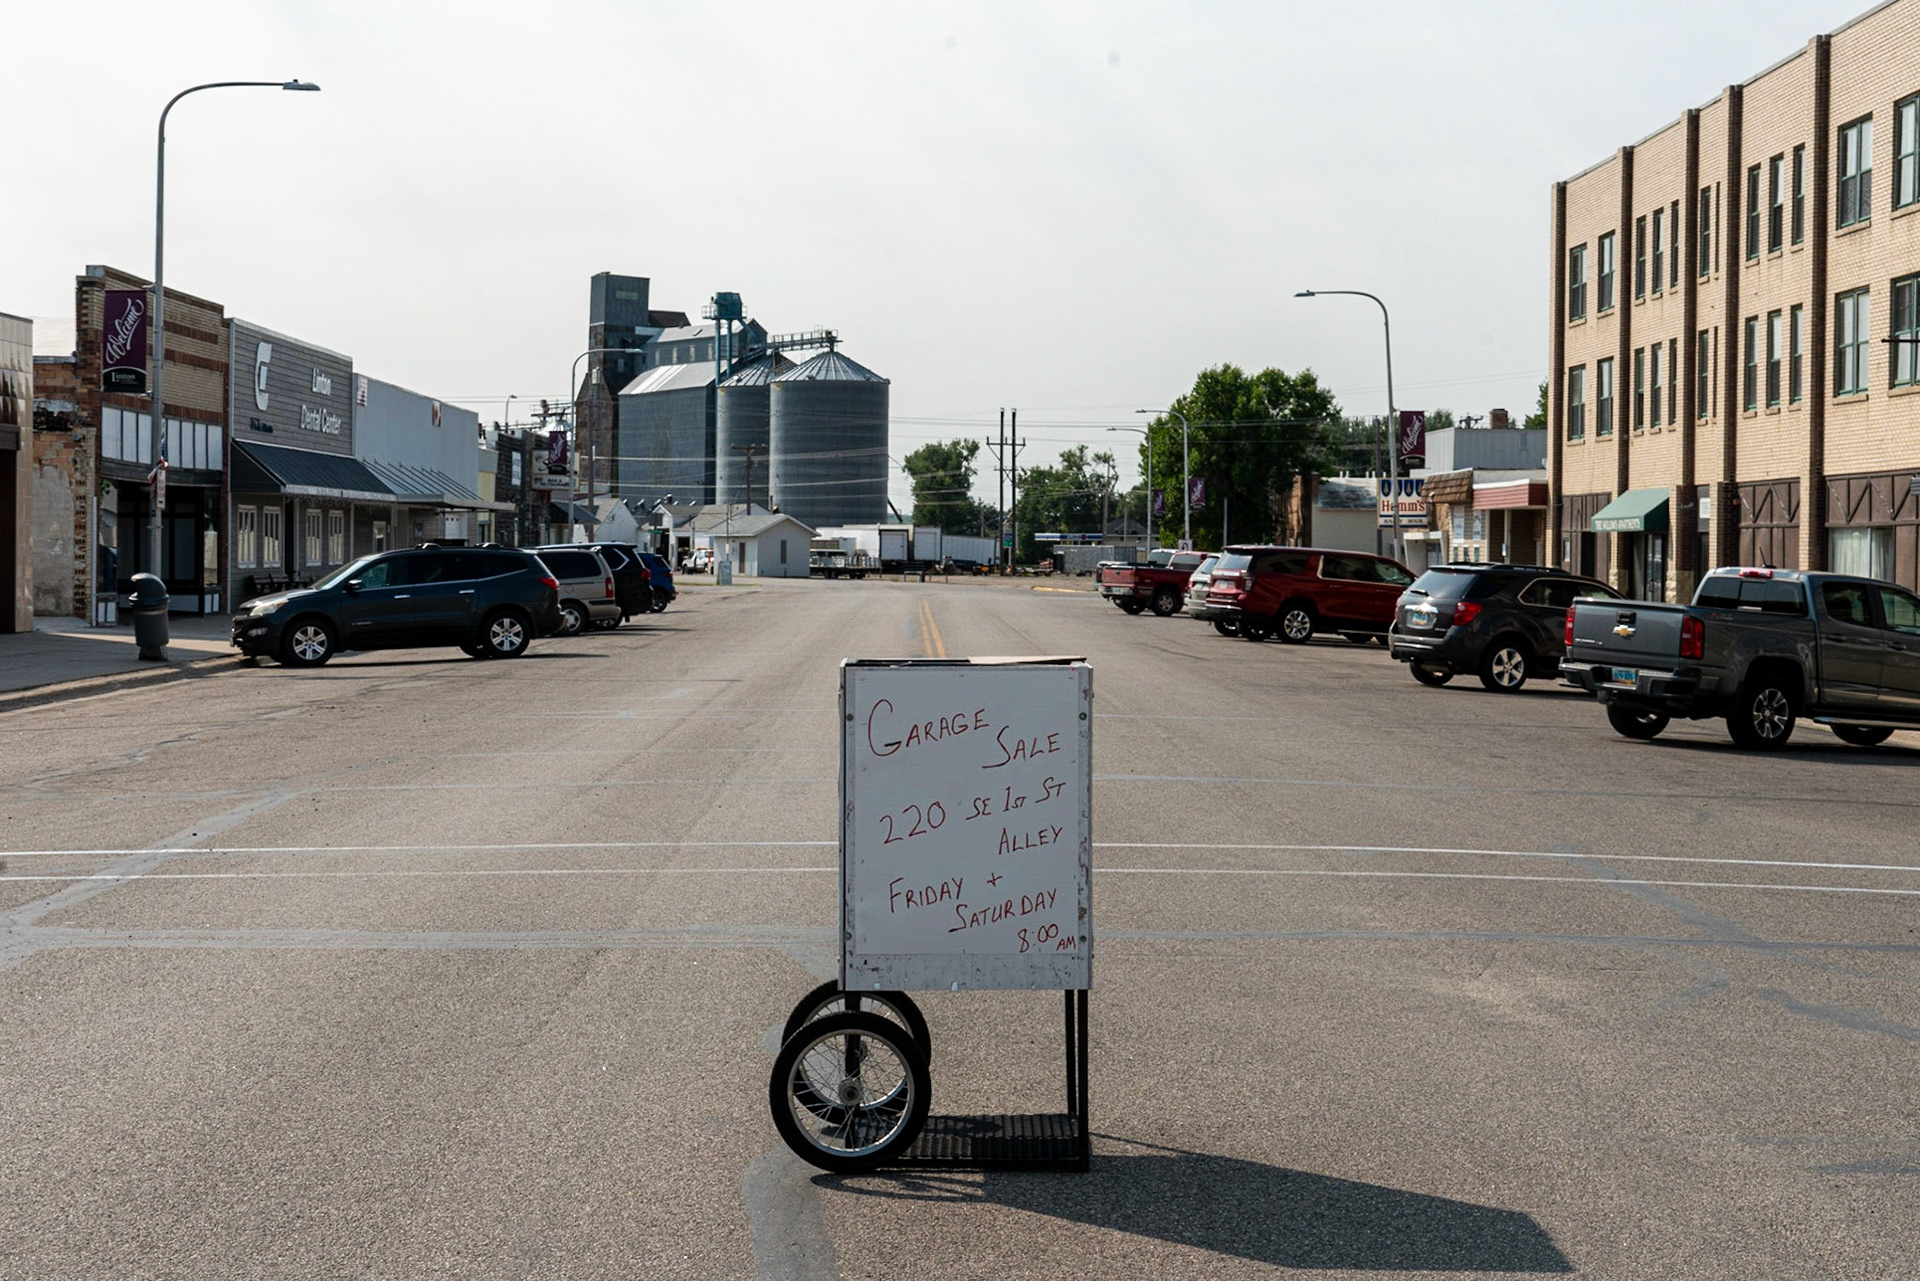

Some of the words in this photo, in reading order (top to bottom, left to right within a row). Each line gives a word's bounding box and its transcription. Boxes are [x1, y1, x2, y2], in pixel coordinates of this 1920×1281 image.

[105, 298, 144, 364] Welcome
[301, 403, 321, 432] Dental
[321, 408, 341, 435] Center
[868, 699, 990, 757] GARAGE
[981, 725, 1061, 769] SALE
[879, 801, 946, 844] 220
[964, 797, 992, 821] SE
[998, 824, 1063, 855] ALLEY
[889, 877, 964, 913] FRIDAY
[948, 888, 1057, 933] SATURDAY
[1017, 923, 1059, 953] 8:00
[1056, 936, 1077, 951] AM
